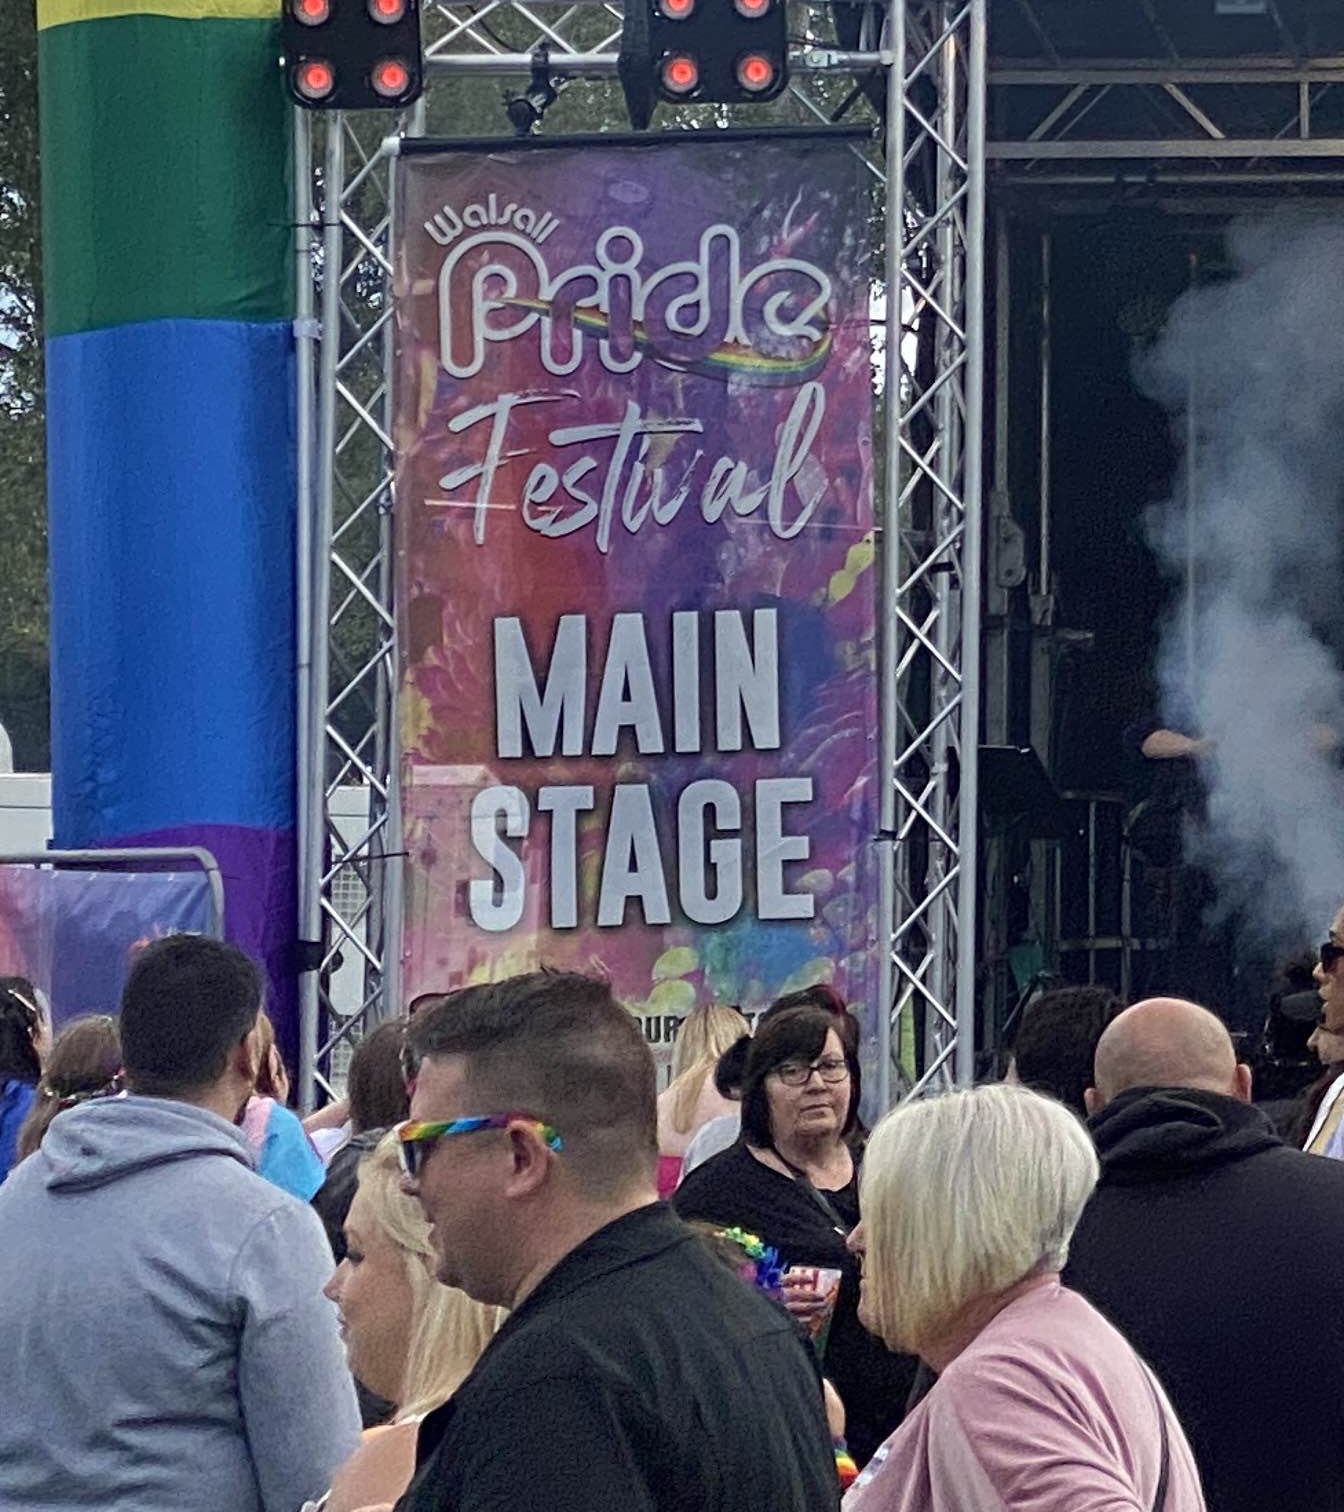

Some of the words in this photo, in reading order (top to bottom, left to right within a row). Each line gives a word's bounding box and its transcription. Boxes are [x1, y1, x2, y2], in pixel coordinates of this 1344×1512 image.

[424, 194, 560, 246] Walsall
[439, 224, 832, 378] Pride
[439, 381, 826, 553] Festival
[494, 608, 781, 759] MAIN
[469, 777, 815, 932] STAGE
